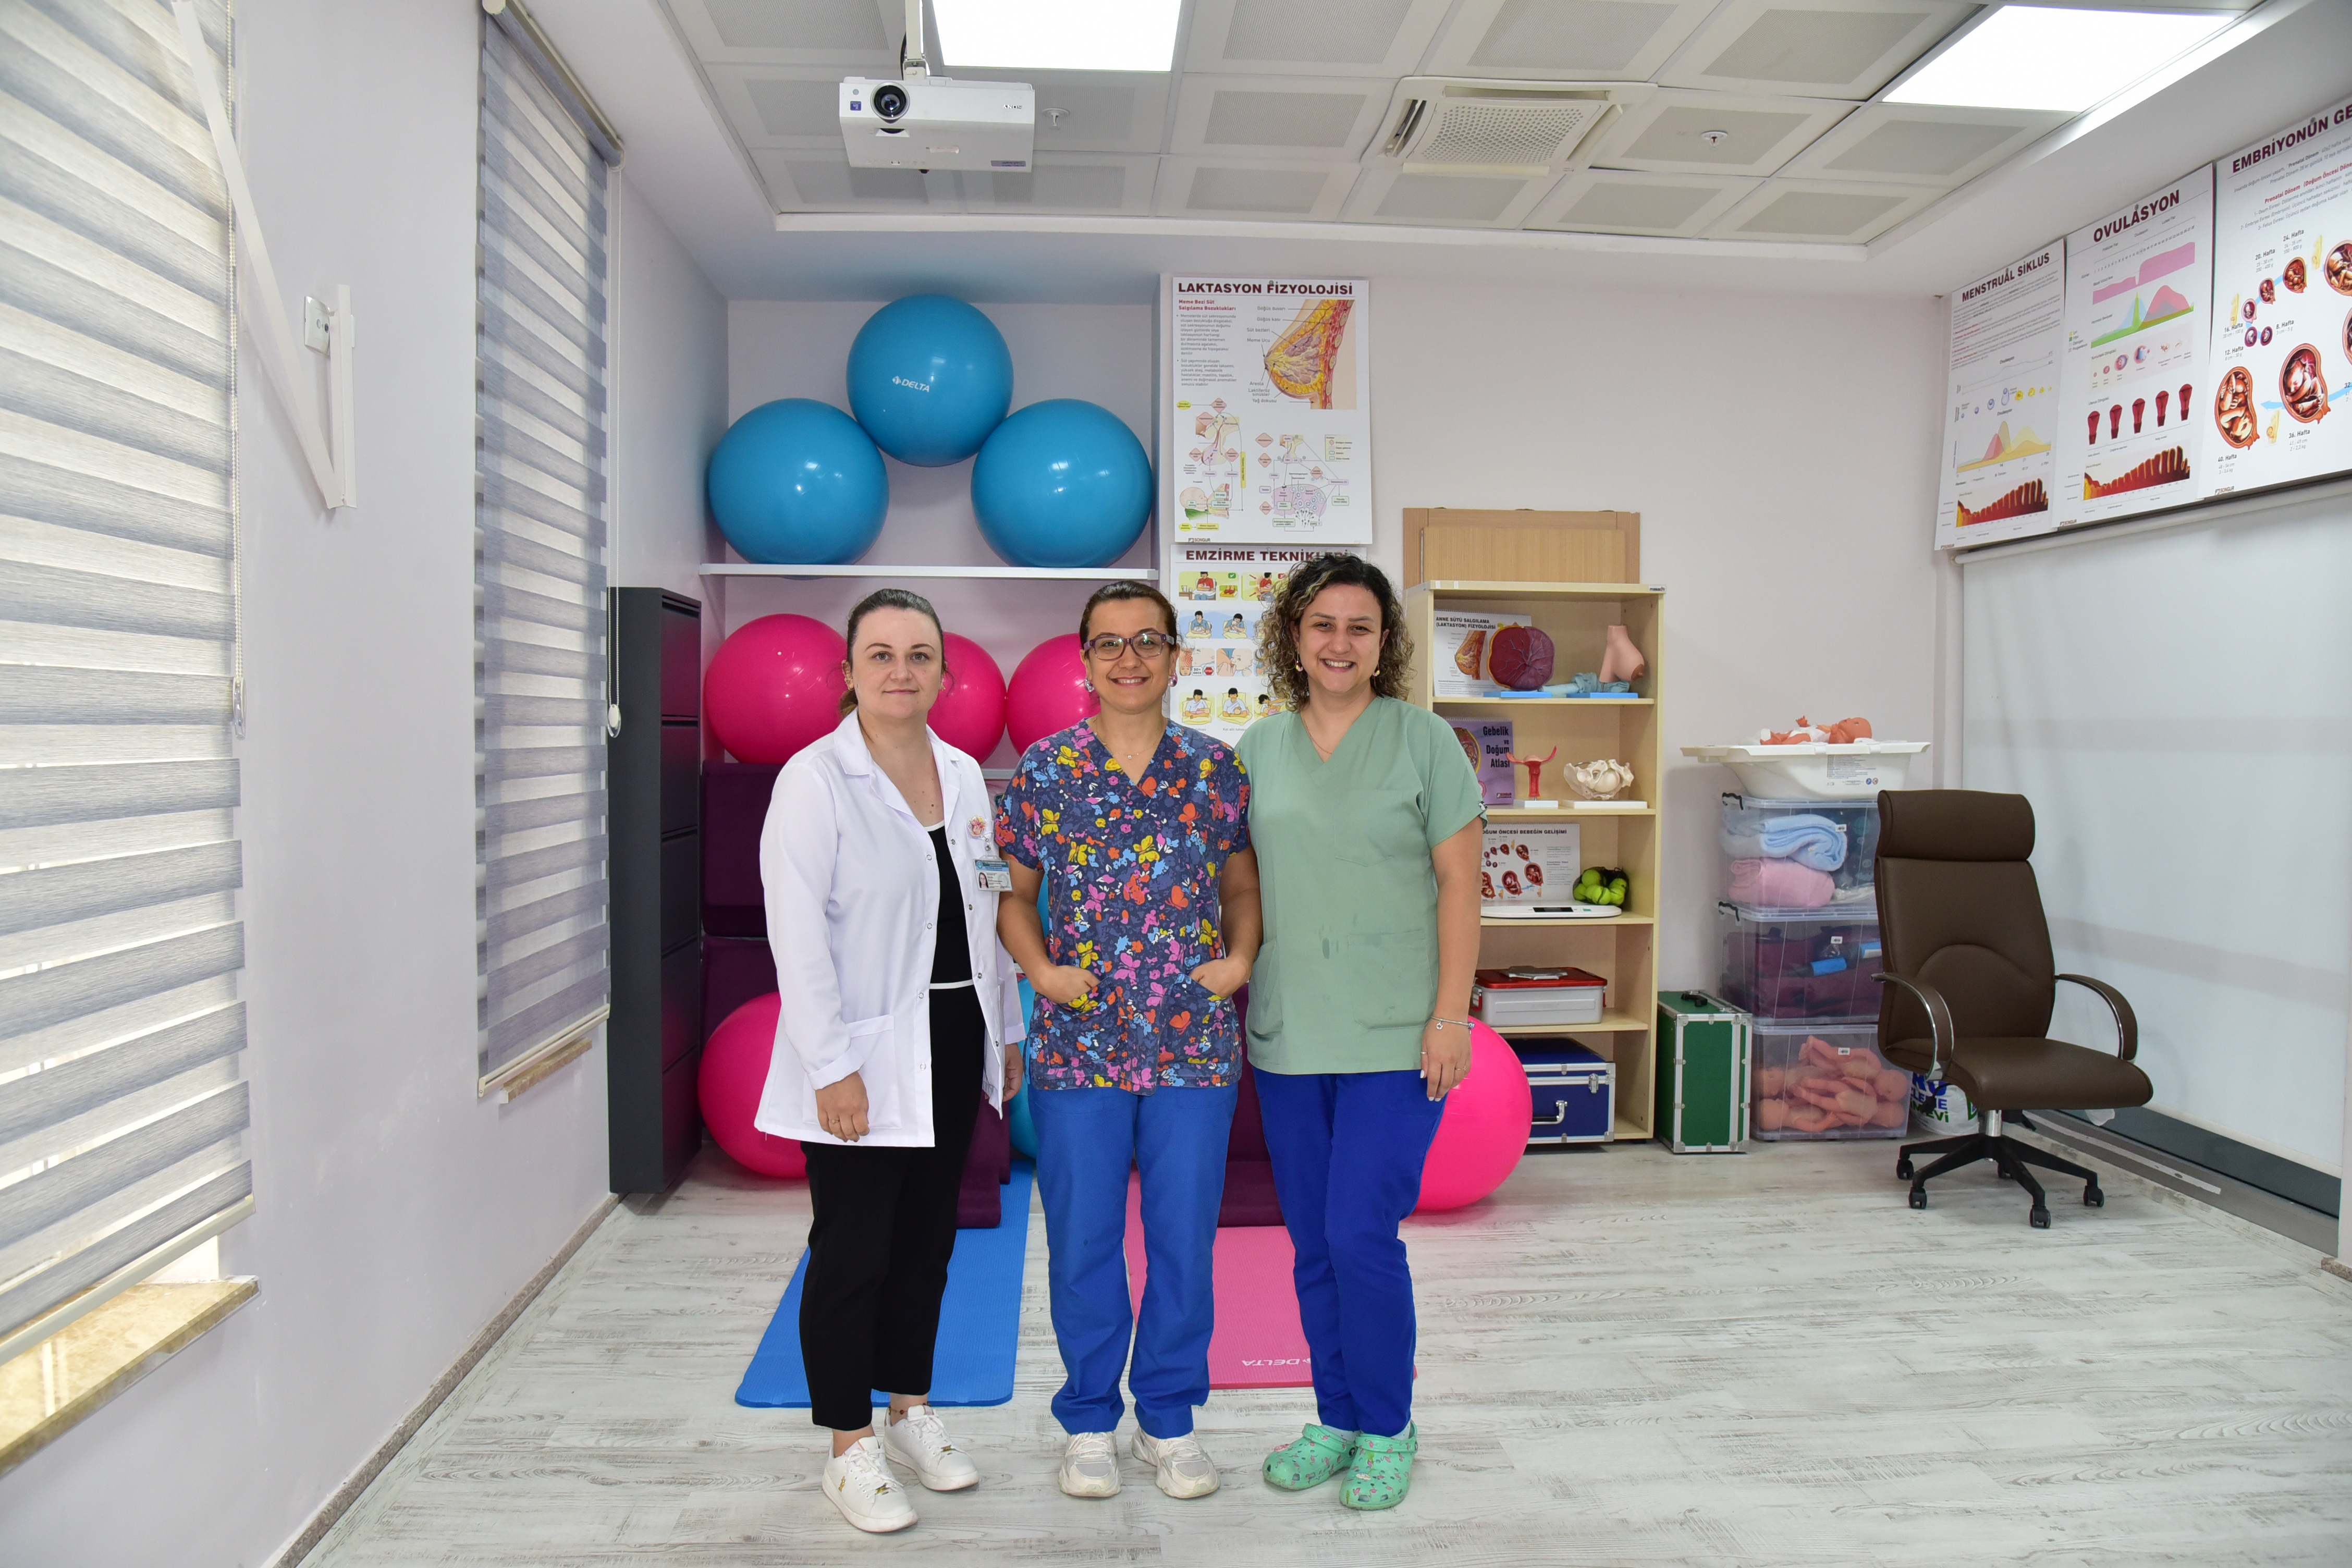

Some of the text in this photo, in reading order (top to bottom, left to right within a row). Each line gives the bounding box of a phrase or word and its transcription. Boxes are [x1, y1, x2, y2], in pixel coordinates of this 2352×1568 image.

[2233, 116, 2328, 173] EMBRİYONUN
[2265, 191, 2283, 204] Prenatal
[2285, 185, 2300, 195] Dönem
[2093, 190, 2179, 242] OVULASYON
[1962, 272, 2015, 302] MENSTRUAL
[2017, 252, 2049, 276] SİKLUS
[1179, 282, 1352, 295] LAKTASYON FİZYOLOJİSİ
[901, 378, 930, 393] DELTA
[1186, 548, 1348, 561] EMZİRME TEKNİK
[1483, 726, 1509, 736] Gebelik
[1486, 745, 1509, 756] Doğum
[1491, 758, 1510, 767] Atlası
